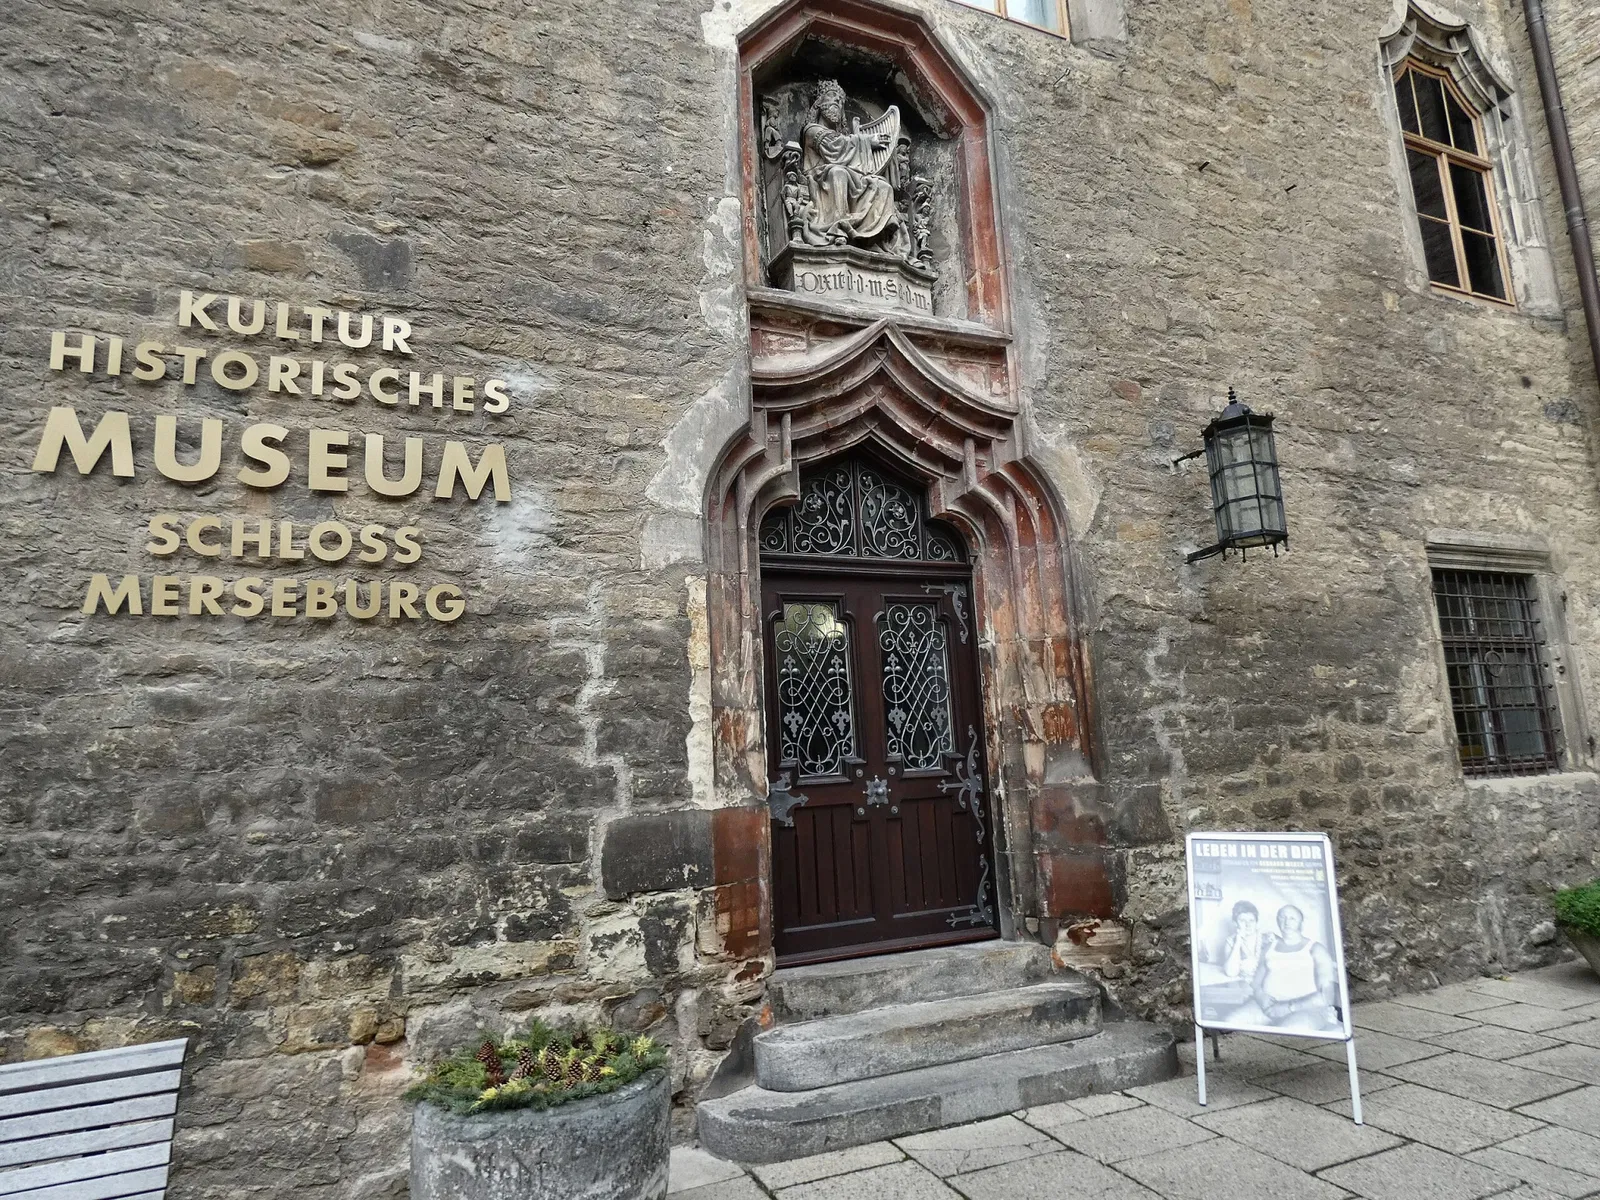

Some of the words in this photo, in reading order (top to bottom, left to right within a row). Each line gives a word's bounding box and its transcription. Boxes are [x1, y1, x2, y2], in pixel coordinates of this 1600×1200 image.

[178, 290, 413, 353] KULTUR
[49, 332, 510, 413] HISTORISCHES
[33, 406, 512, 501] MUSEUM
[146, 514, 422, 563] SCHLOSS
[82, 573, 466, 621] MERSEBURG
[1195, 843, 1237, 858] LEBEN
[1240, 844, 1257, 858] IN
[1259, 845, 1288, 859] DER
